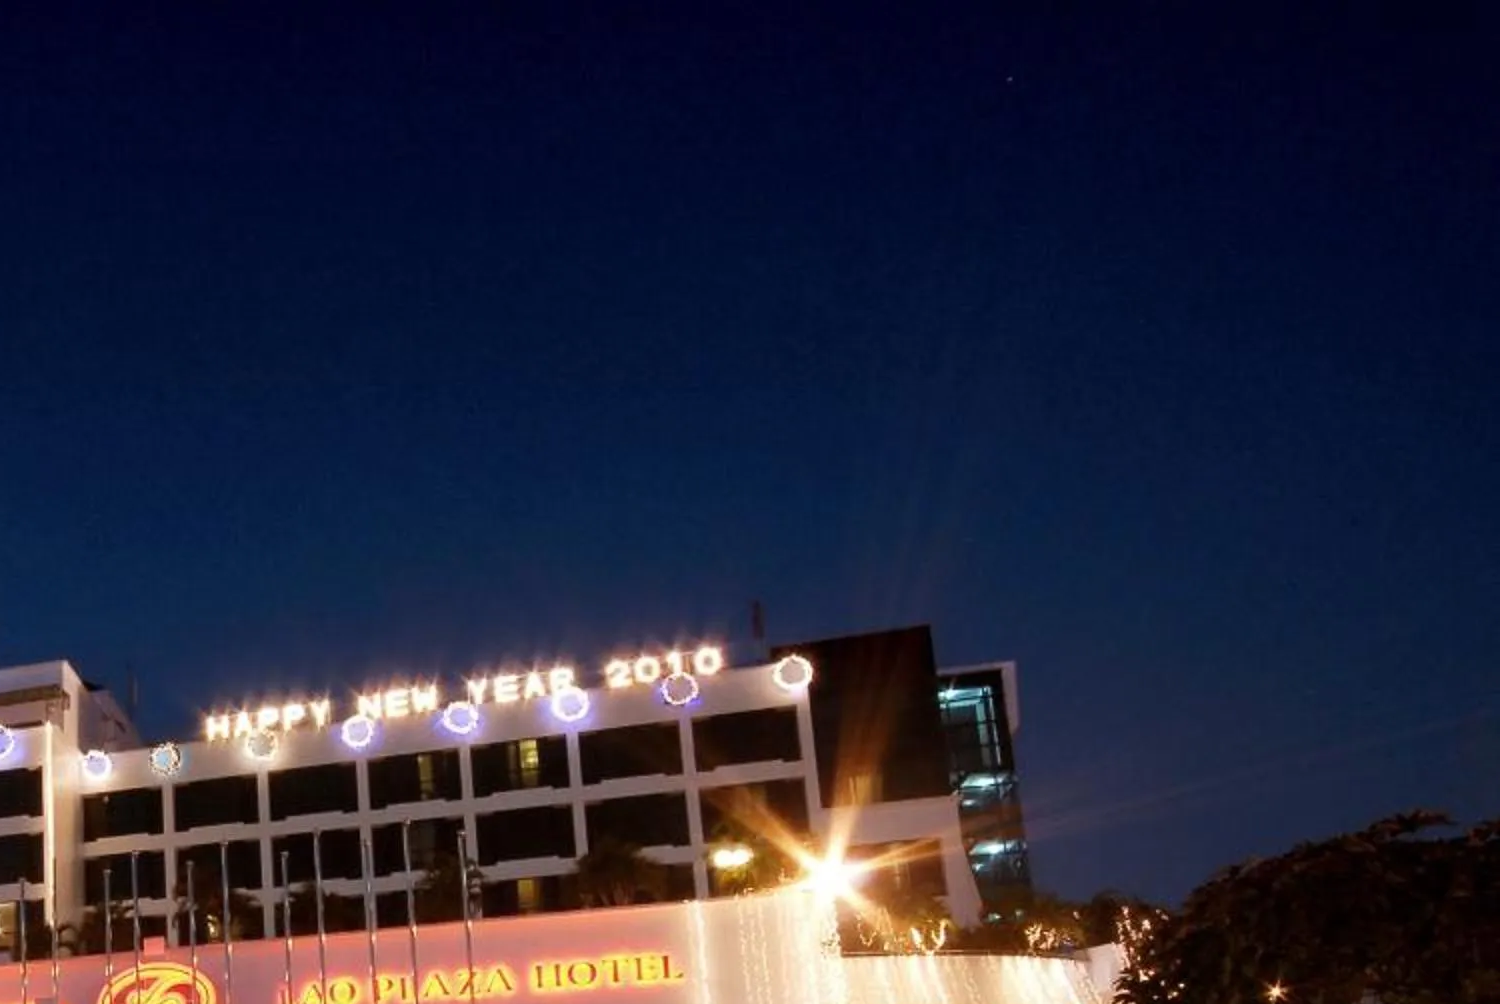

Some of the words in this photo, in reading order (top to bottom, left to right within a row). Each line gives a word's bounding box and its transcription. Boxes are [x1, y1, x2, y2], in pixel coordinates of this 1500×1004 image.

[203, 696, 332, 742] HAPPY
[354, 683, 440, 722] NEW
[465, 665, 574, 706] YEAR
[603, 646, 724, 690] 2010
[370, 965, 515, 1003] PLAZA
[533, 953, 686, 990] HOTEL
